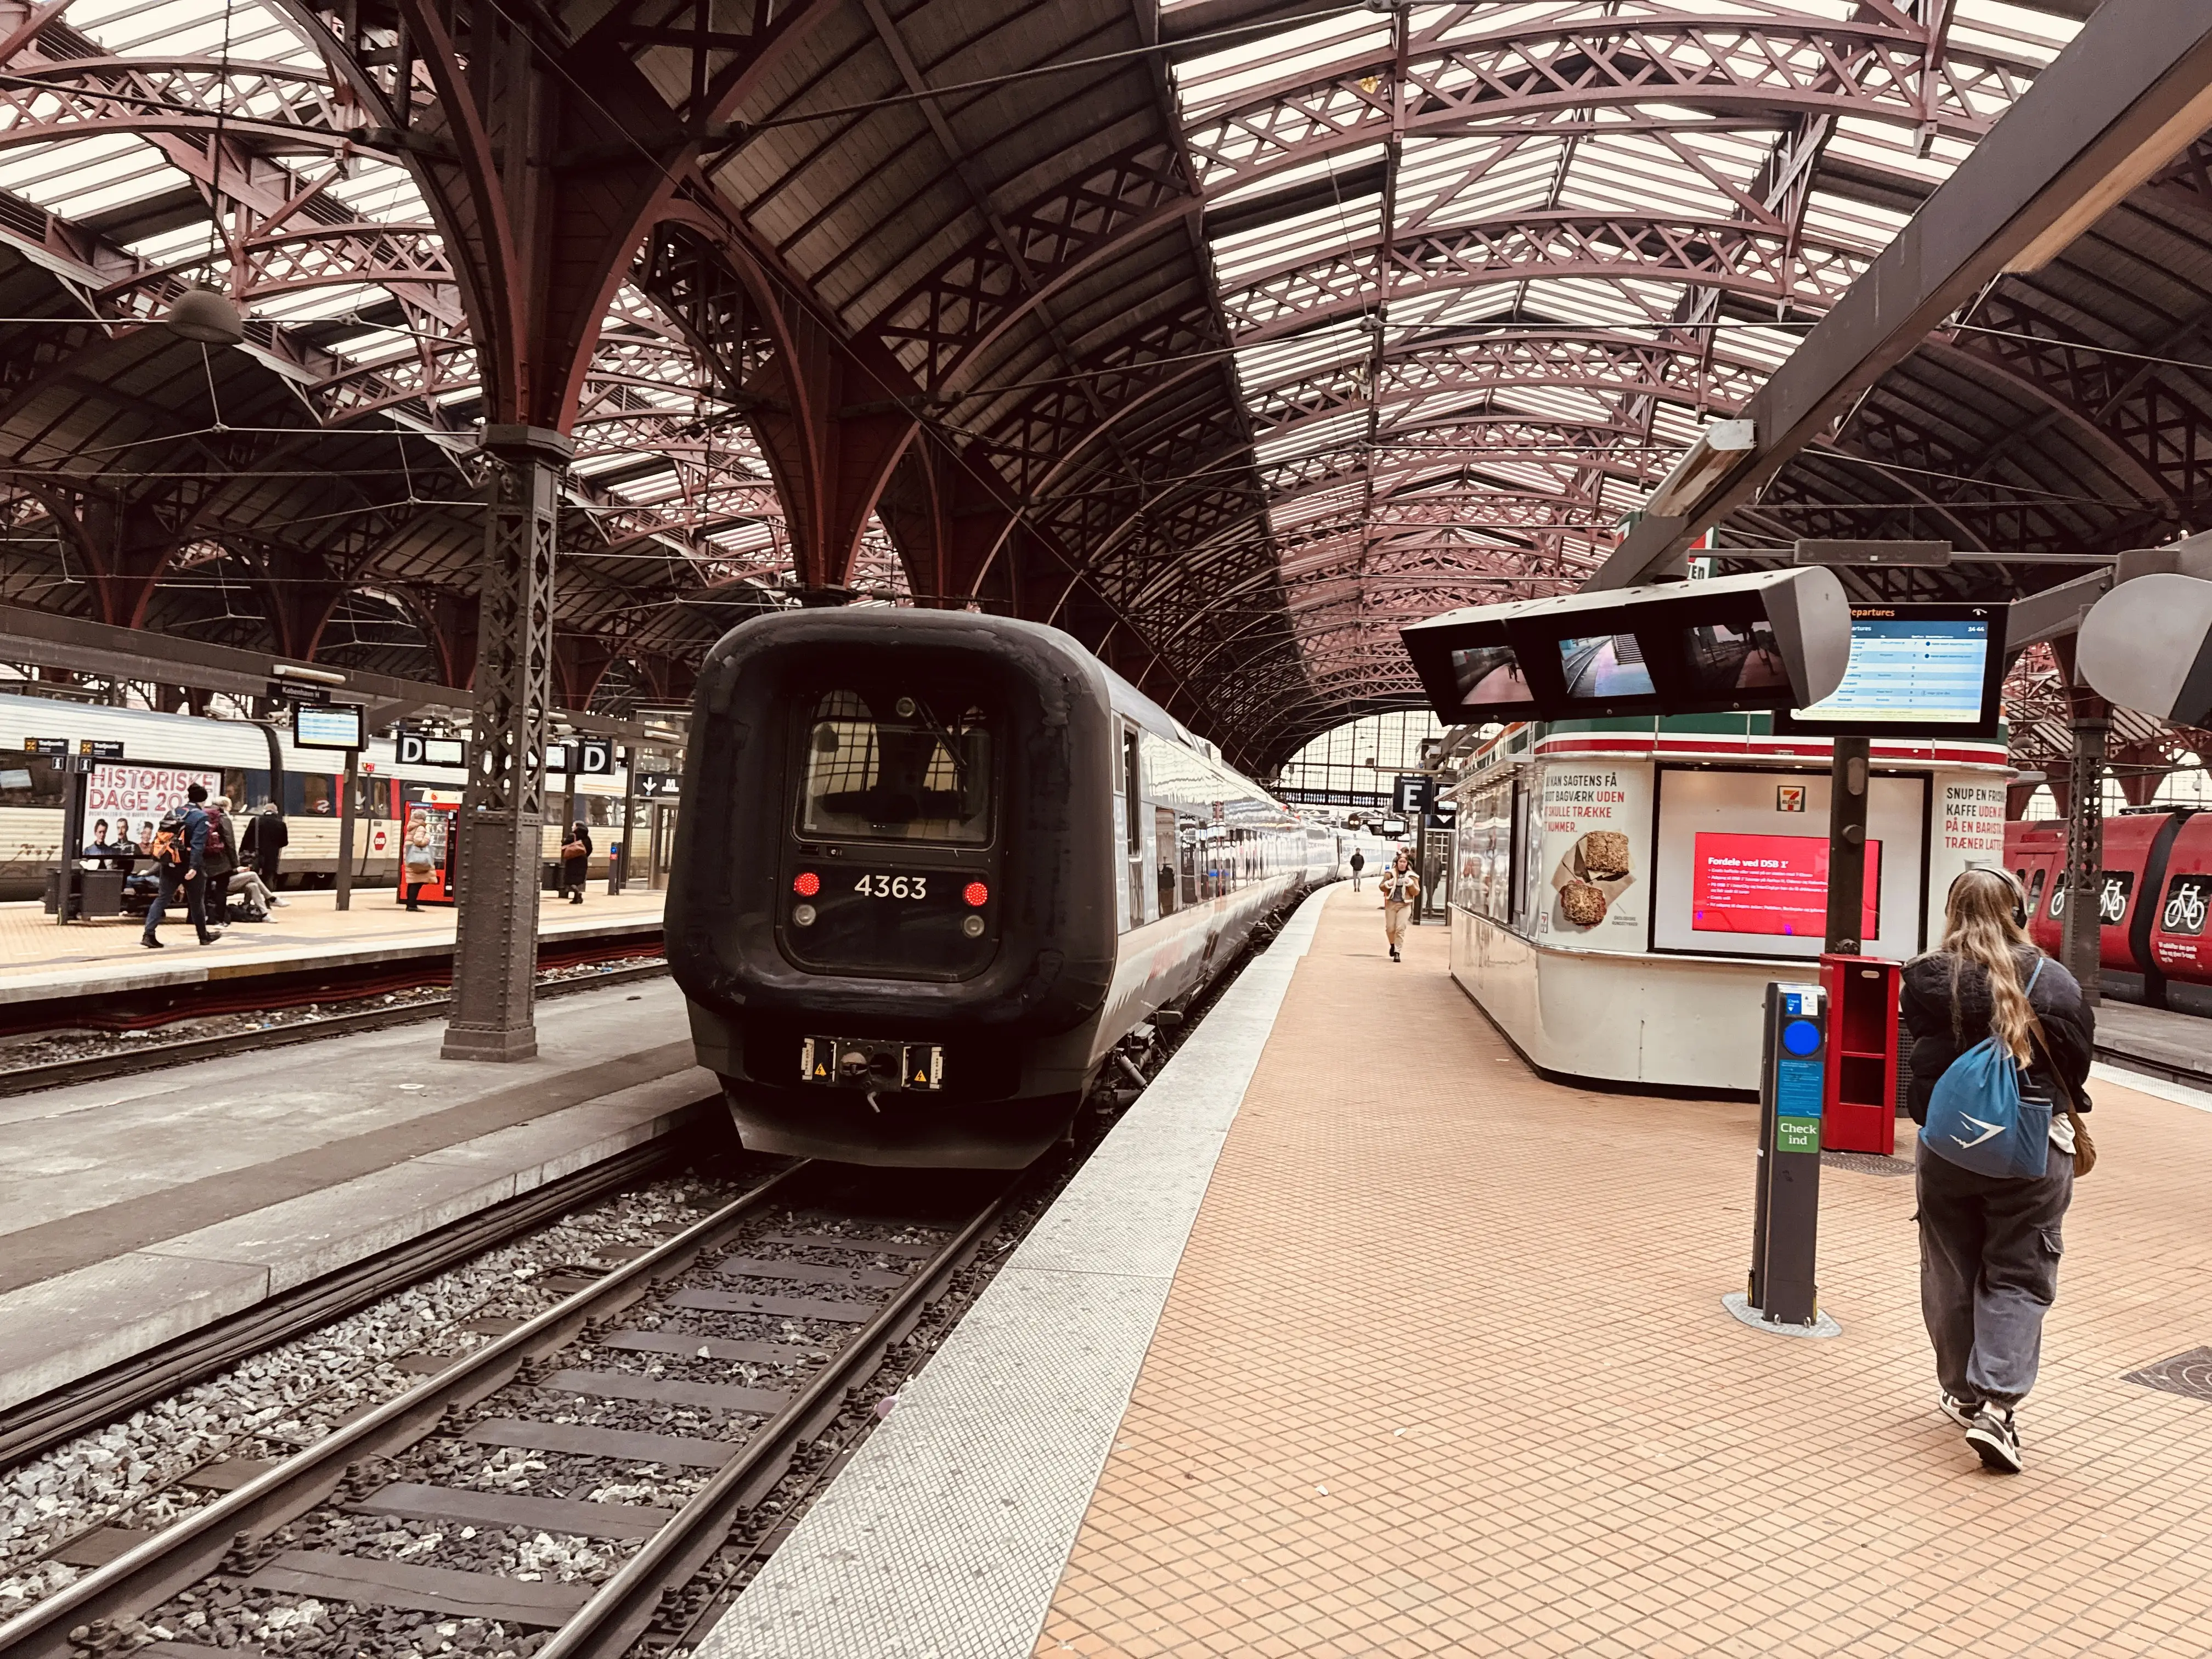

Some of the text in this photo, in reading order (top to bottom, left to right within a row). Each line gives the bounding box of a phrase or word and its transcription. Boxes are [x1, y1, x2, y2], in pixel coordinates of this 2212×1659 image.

[1850, 608, 1895, 618] epartures
[402, 737, 422, 762] D
[583, 746, 606, 771] D
[91, 768, 213, 791] HISTORISKE
[1563, 775, 1602, 787] SAGTENS
[1605, 771, 1617, 787] FÅ
[89, 789, 149, 811] DAGE
[1403, 785, 1423, 811] E
[1555, 791, 1594, 802] BAGVÆRK
[1596, 791, 1625, 803] UDEN
[1946, 787, 1974, 800] SNUP
[1976, 789, 1987, 800] EN
[1548, 806, 1570, 817] SKULLE
[1572, 806, 1612, 818] TRÆKKE
[1946, 804, 1977, 816] KAFFE
[1979, 805, 1996, 817] UDEN
[1945, 817, 1959, 832] PÅ
[1961, 821, 1973, 832] EN
[1945, 837, 1984, 849] TRÆNER
[1708, 857, 1741, 866] Fordele
[1742, 859, 1759, 867] ved
[1760, 860, 1779, 868] DSB
[854, 874, 927, 899] 4363
[1780, 1123, 1817, 1135] Check
[1788, 1135, 1808, 1145] ind
